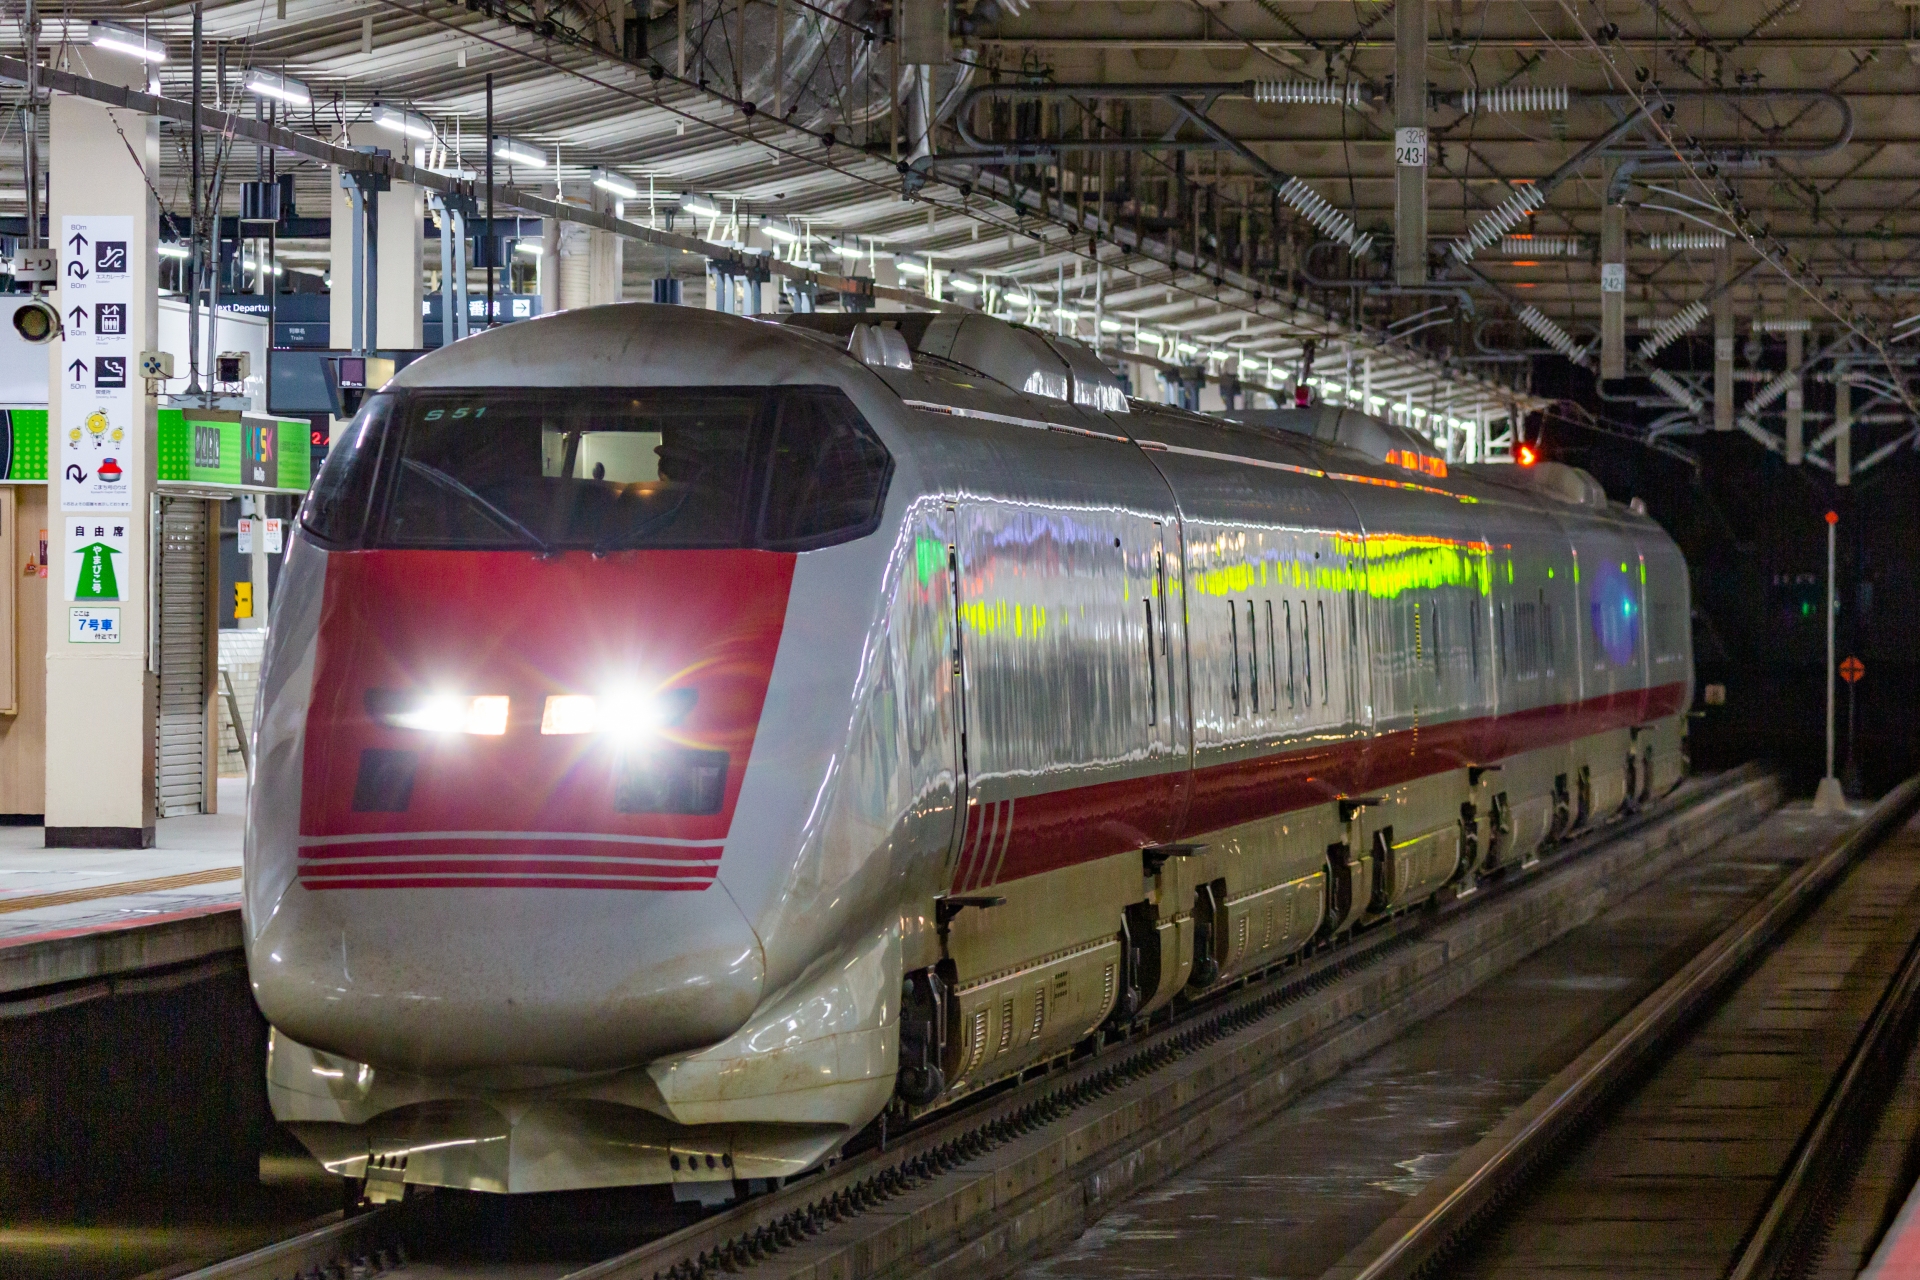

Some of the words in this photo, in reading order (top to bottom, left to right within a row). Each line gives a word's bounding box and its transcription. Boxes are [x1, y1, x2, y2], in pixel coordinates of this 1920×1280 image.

[1405, 130, 1426, 144] 32R
[18, 258, 52, 272] 上り
[245, 425, 273, 463] KIOSK
[75, 525, 124, 537] 自由席
[92, 545, 102, 594] やまびこ号
[78, 619, 113, 632] 7号車
